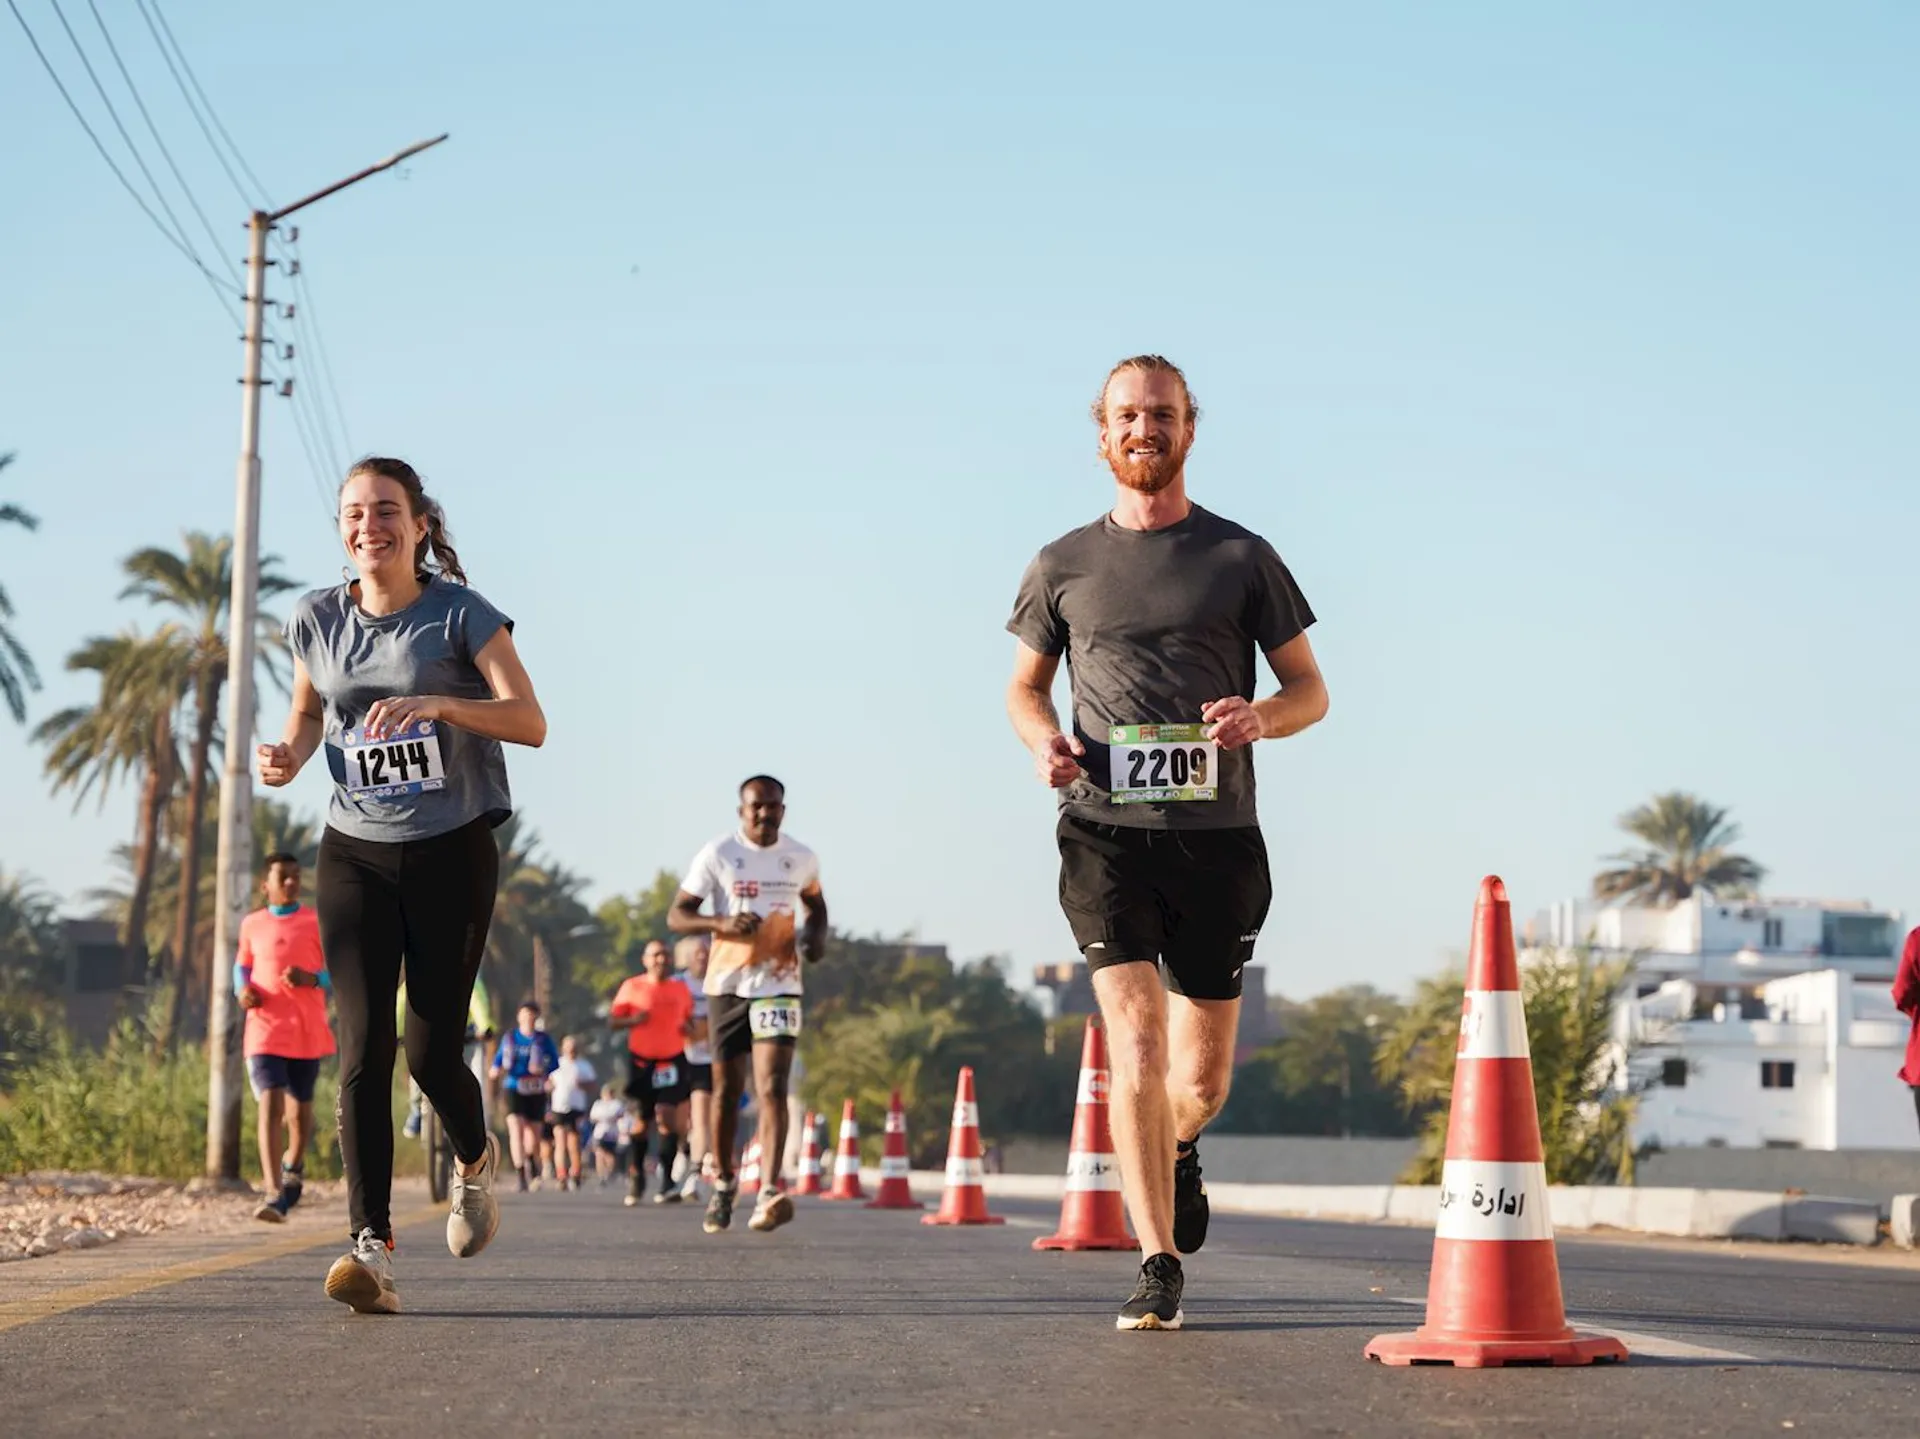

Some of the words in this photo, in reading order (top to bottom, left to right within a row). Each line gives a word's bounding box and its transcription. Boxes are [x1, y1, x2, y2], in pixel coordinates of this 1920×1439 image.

[356, 741, 429, 786] 1244
[1128, 748, 1207, 788] 2209
[1471, 1183, 1525, 1217] ادارة
